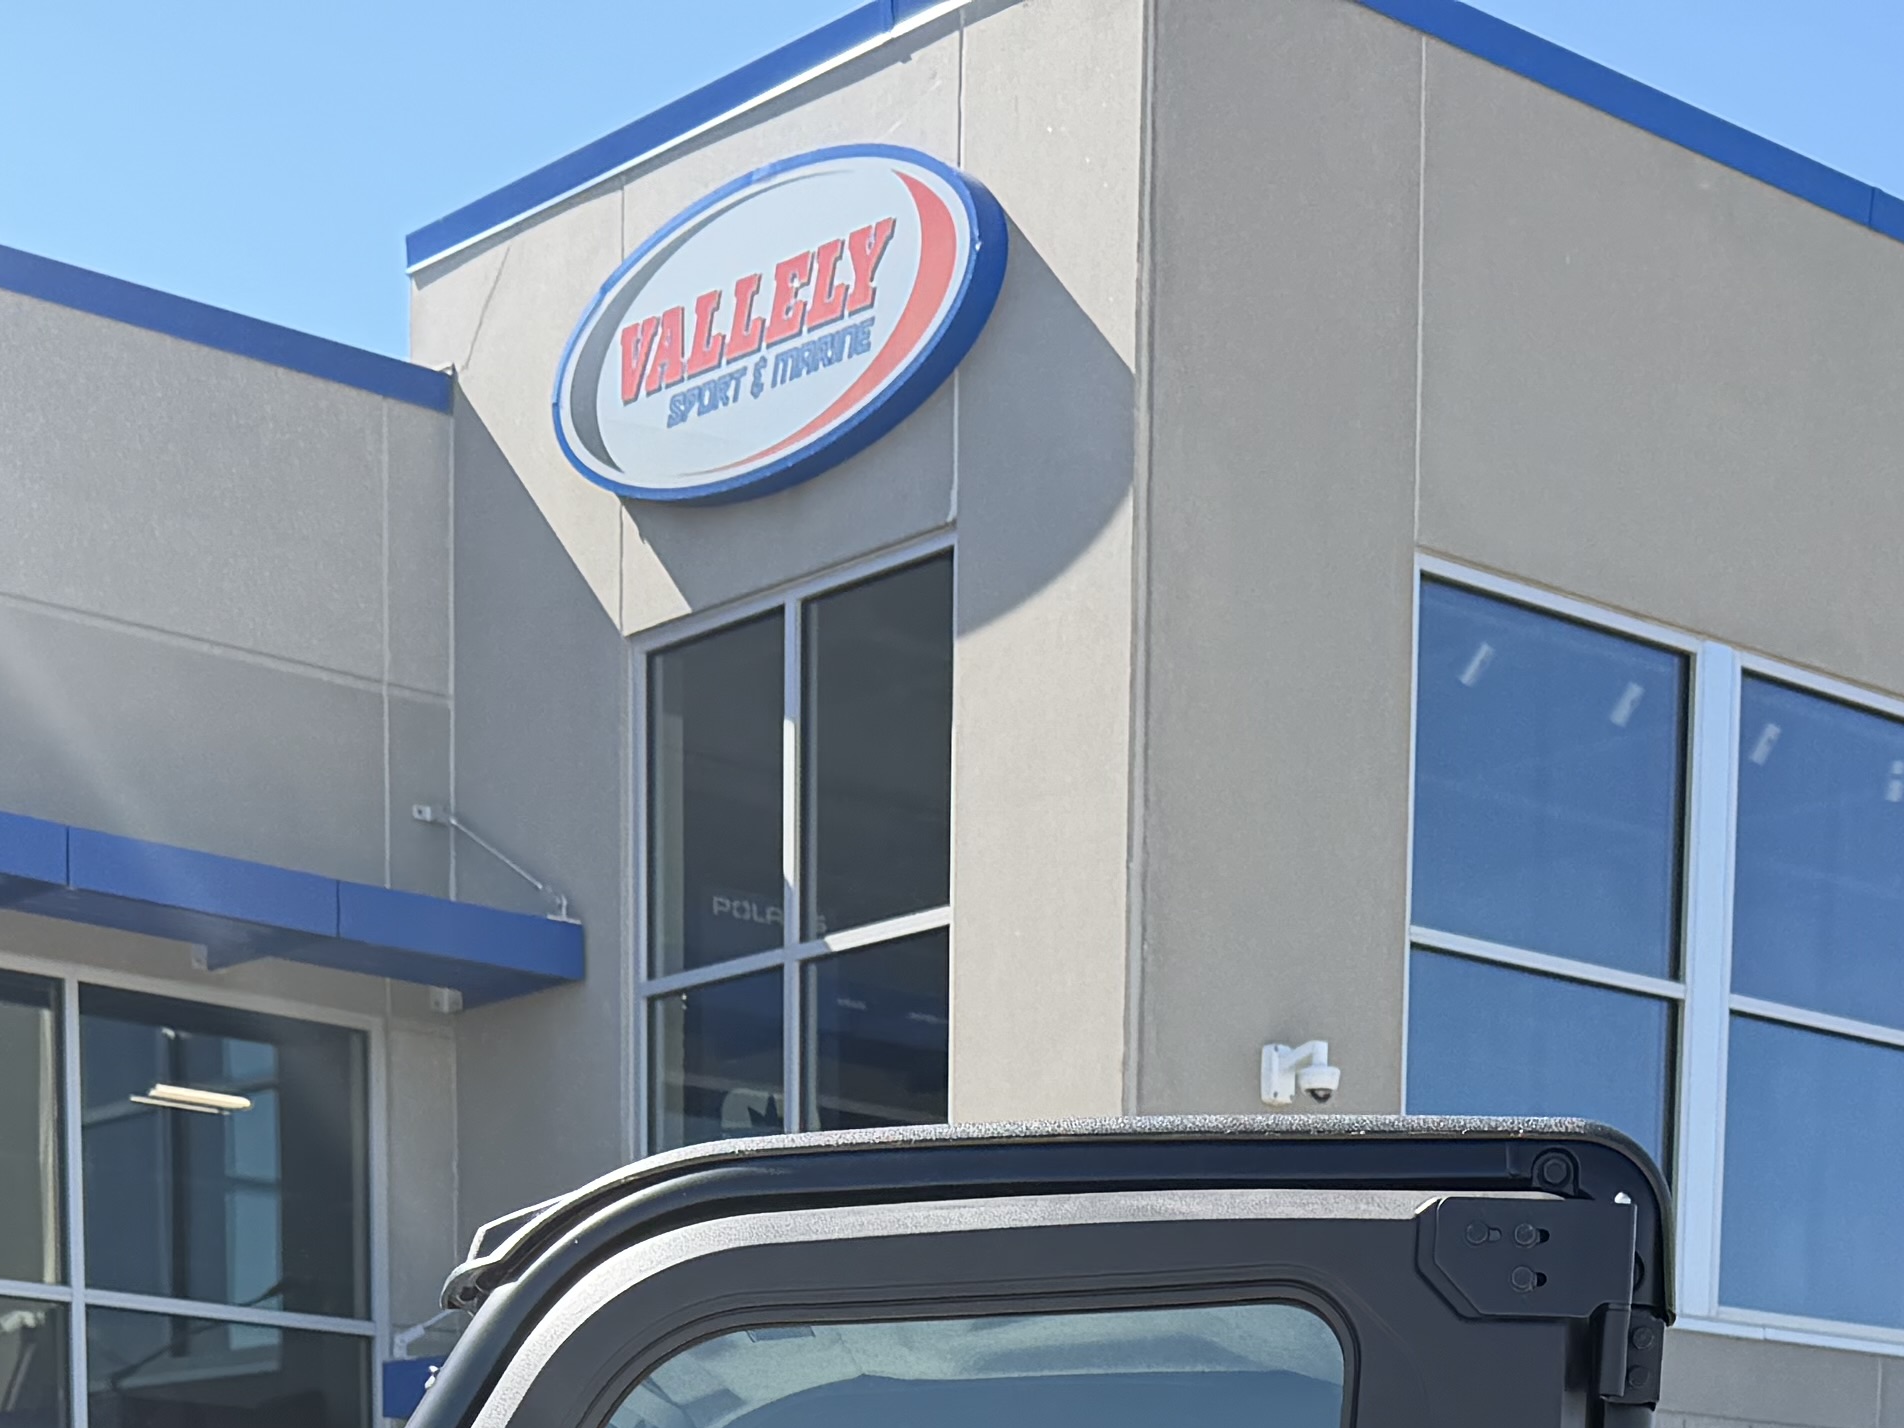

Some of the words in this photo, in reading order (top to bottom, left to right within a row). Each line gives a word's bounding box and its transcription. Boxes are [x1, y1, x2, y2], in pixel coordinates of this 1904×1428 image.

[620, 217, 896, 406] VALLELY
[666, 365, 749, 428] SPORT
[750, 354, 768, 399] &
[770, 315, 876, 388] MARINE
[712, 896, 827, 934] POLAS
